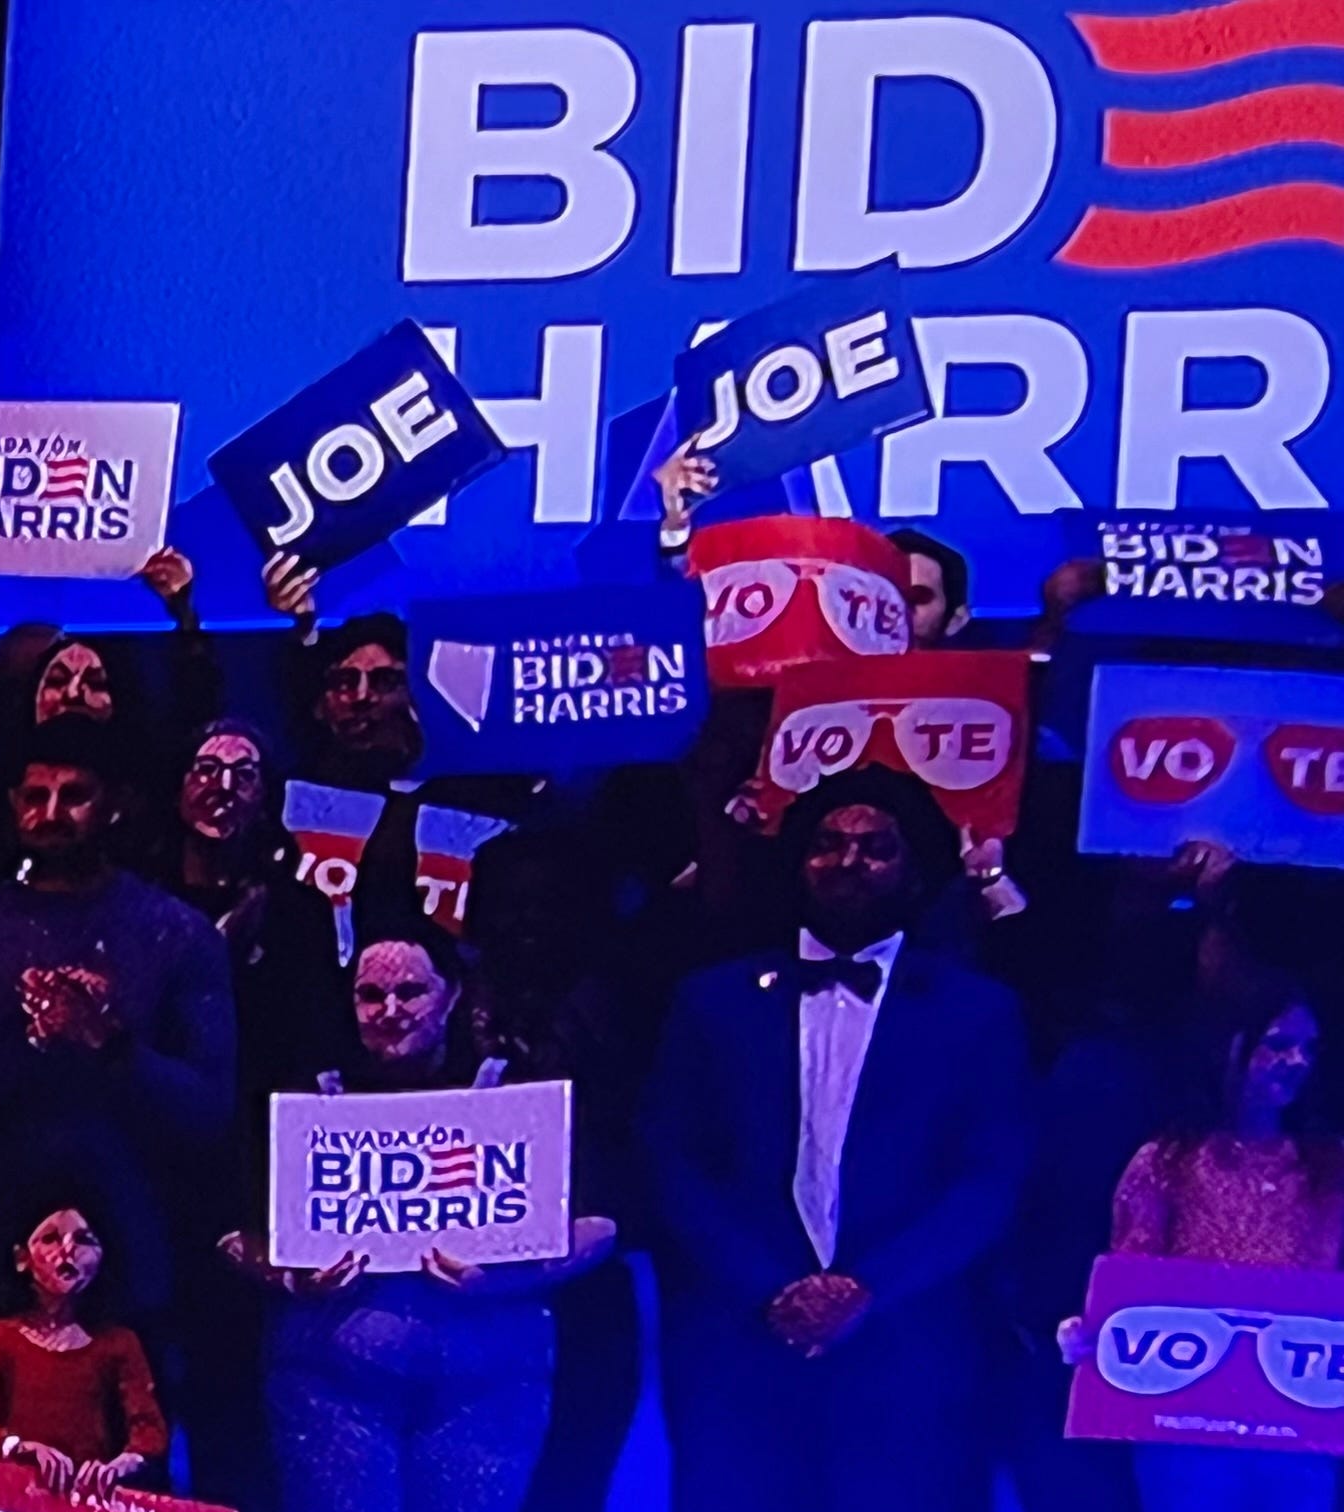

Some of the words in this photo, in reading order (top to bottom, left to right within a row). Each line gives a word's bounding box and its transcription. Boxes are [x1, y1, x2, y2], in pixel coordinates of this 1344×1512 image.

[696, 311, 900, 450] JOE
[267, 371, 458, 546] JOE
[1102, 534, 1323, 566] BIDEN
[1106, 561, 1324, 606] HARRIS
[513, 644, 685, 691] BIDEN
[513, 683, 688, 724] HARRIS
[311, 1142, 526, 1192] BIDEN
[311, 1189, 527, 1233] HARRIS
